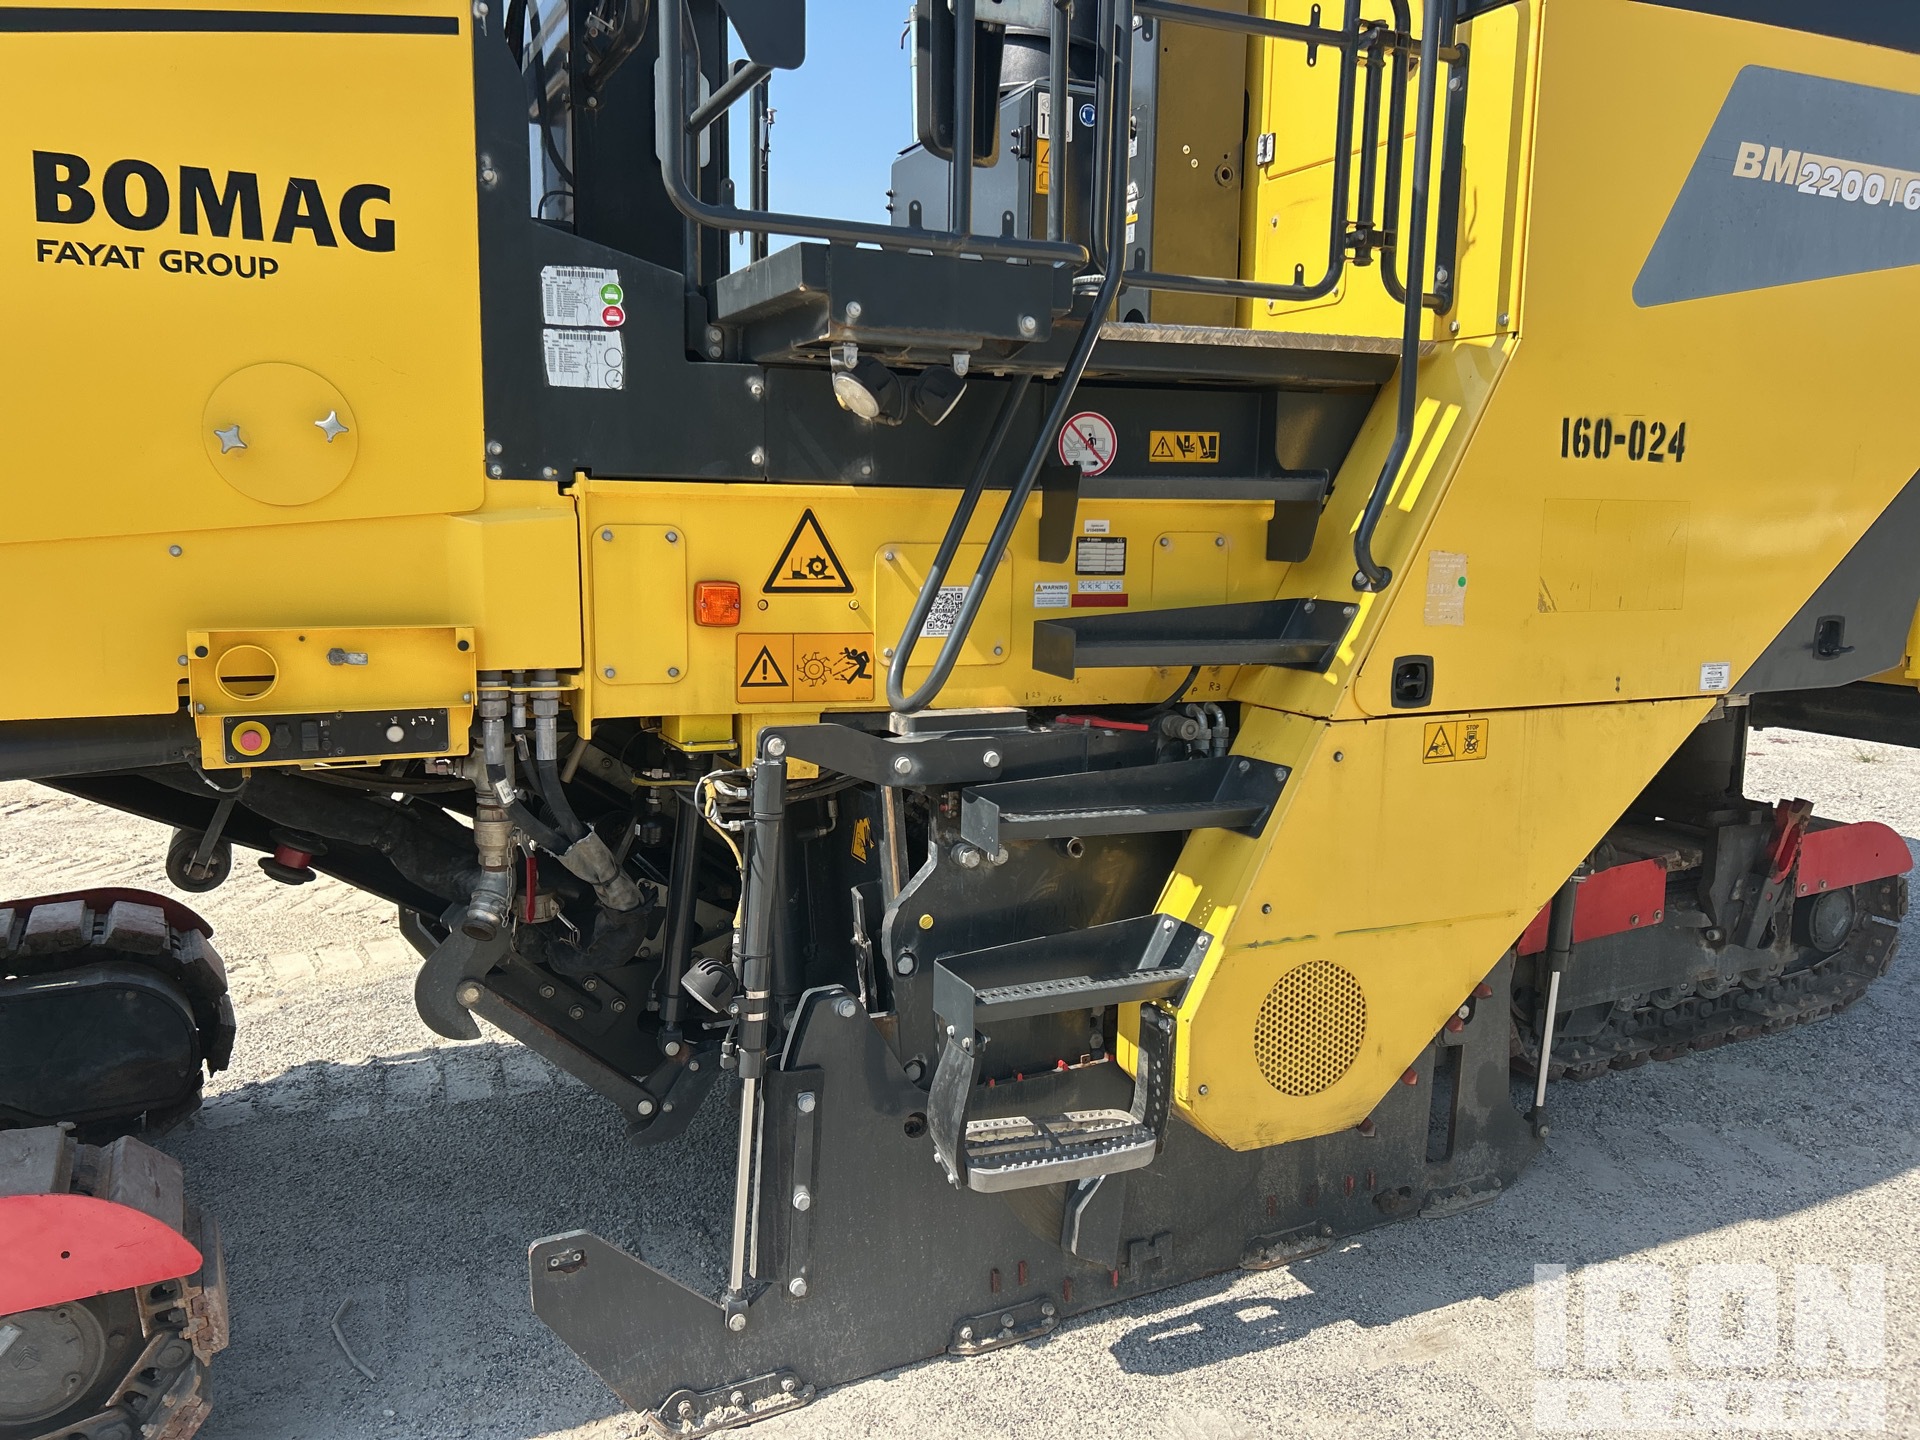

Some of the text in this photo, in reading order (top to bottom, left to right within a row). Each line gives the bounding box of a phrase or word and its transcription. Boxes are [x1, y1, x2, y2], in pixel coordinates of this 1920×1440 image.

[32, 150, 395, 252] BOMAG
[37, 239, 279, 280] FAYAT GROUP
[1561, 417, 1686, 463] 160-024
